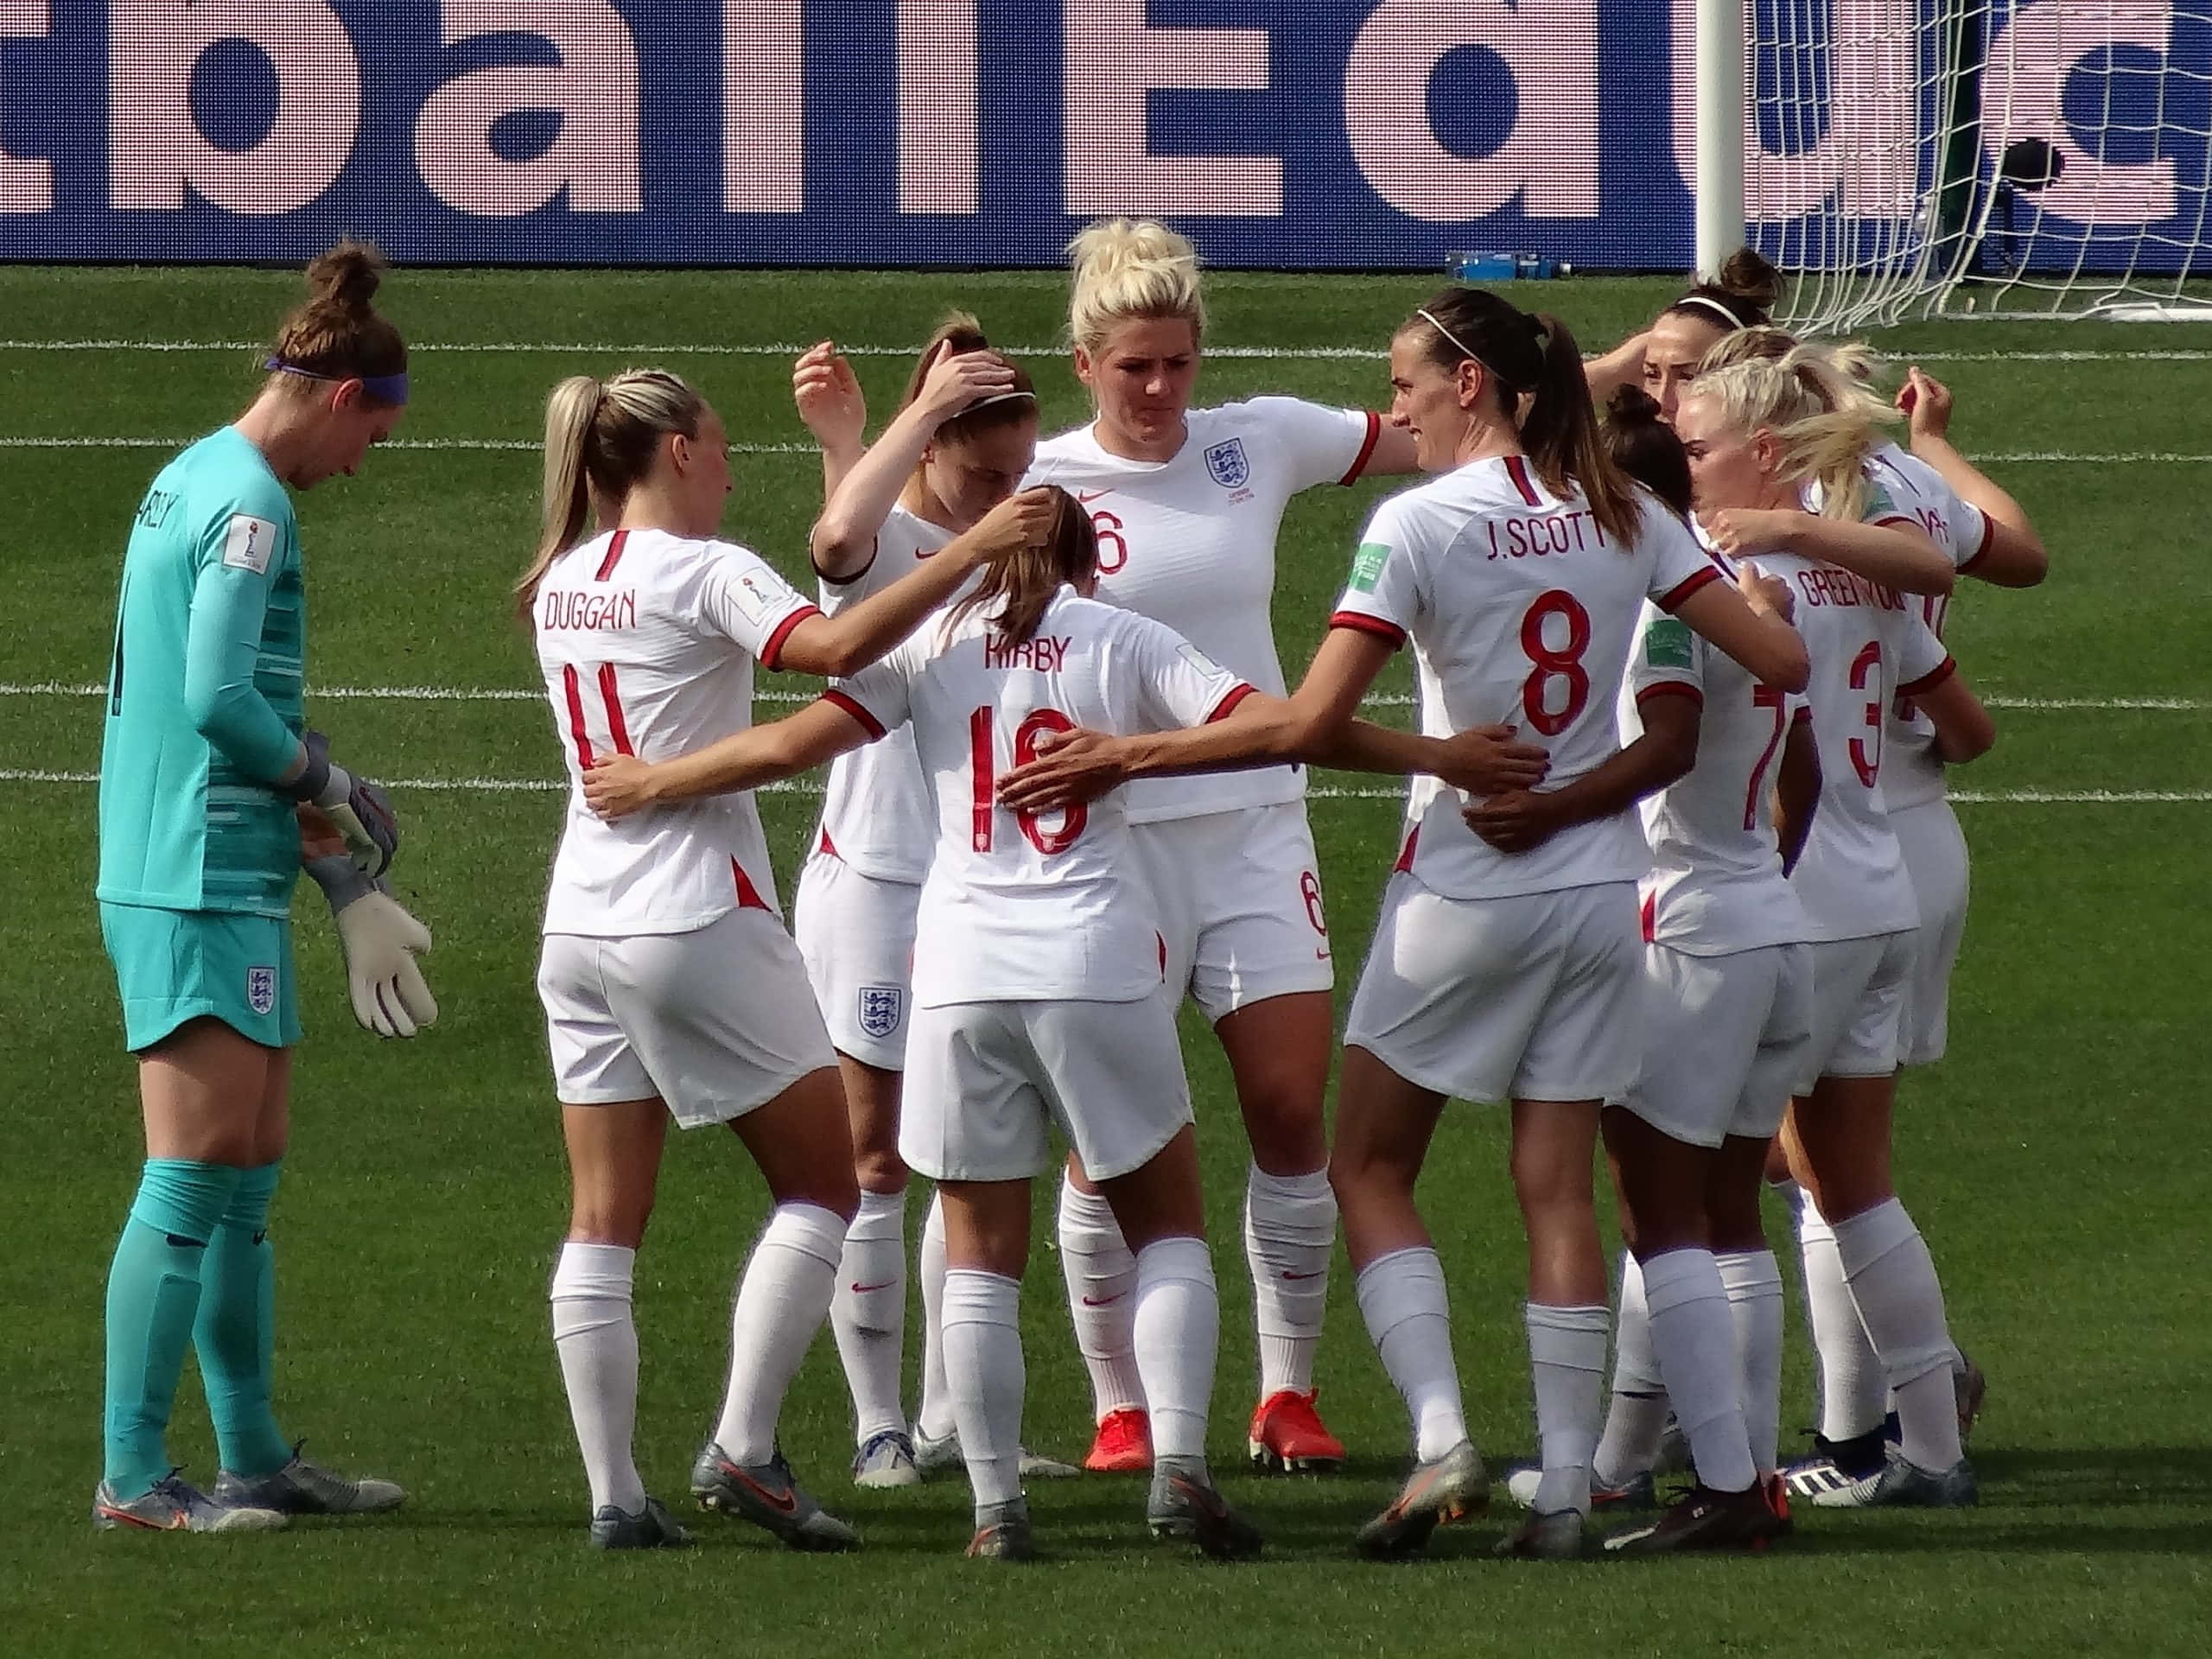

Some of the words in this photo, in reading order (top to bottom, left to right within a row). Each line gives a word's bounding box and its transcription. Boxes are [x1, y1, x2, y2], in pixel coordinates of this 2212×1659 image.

[1092, 511, 1128, 575] 6
[1487, 511, 1605, 560] J.SCOTT
[544, 588, 636, 631] DUGGAN
[1521, 588, 1591, 737] 8
[563, 662, 635, 770] 11
[1743, 683, 1786, 831] 7
[1300, 870, 1327, 938] 6
